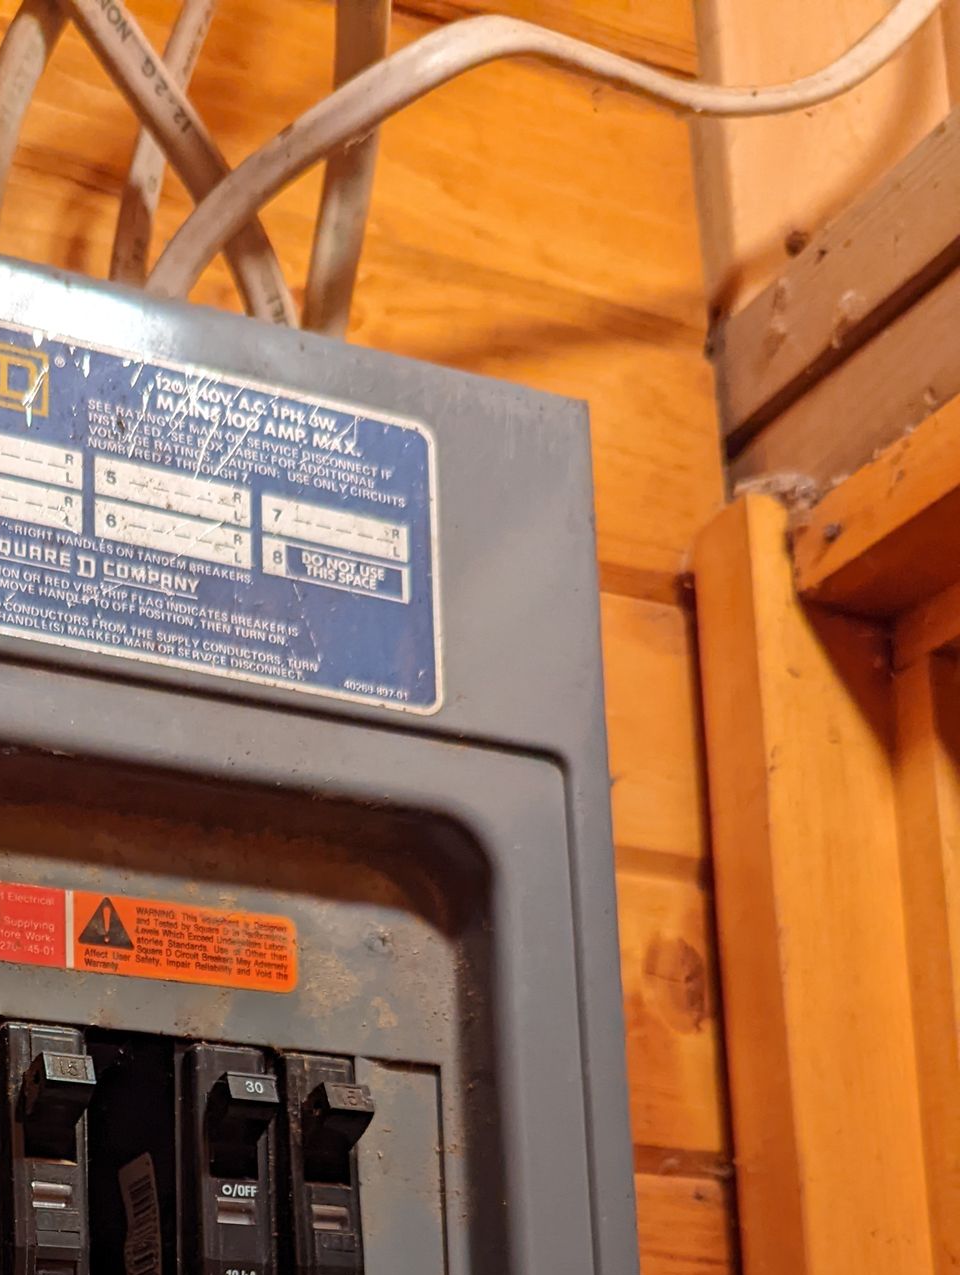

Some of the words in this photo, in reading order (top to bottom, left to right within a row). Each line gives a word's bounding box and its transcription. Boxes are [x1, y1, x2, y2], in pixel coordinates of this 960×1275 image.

[88, 399, 111, 413] SEE
[116, 406, 165, 426] RATING
[169, 418, 185, 431] OF
[189, 422, 221, 439] MAIN
[247, 437, 298, 458] SERVICE
[302, 450, 377, 477] DISCONNECT
[381, 469, 391, 481] IF
[227, 411, 259, 433] 100
[263, 420, 307, 444] AMP.
[312, 432, 361, 457] MAX.
[65, 453, 73, 465] R
[88, 412, 164, 439] INSTLLED.
[171, 431, 193, 446] SEE
[197, 437, 222, 452] BOX
[271, 455, 295, 470] FOR
[300, 462, 374, 489] ADDITIONAL
[88, 437, 161, 463] NUMBERED
[164, 454, 171, 465] 2
[176, 457, 236, 480] THROUGH
[106, 470, 116, 485] 5
[287, 471, 309, 486] USE
[313, 477, 346, 494] ONLY
[350, 485, 405, 508] CIRCUITS
[64, 496, 72, 507] R
[233, 492, 241, 503] R
[105, 513, 116, 528] 6
[272, 508, 281, 523] 7
[233, 533, 241, 545] R
[392, 528, 399, 539] R
[56, 533, 112, 554] HANDLES
[116, 546, 133, 559] ON
[138, 551, 185, 569] TANDEM
[272, 550, 282, 564] 8
[302, 551, 322, 567] DO
[326, 557, 356, 574] NOT
[360, 565, 384, 581] USE
[77, 555, 95, 579] D
[103, 560, 199, 593] COMPANY
[305, 565, 335, 581] THIS
[338, 572, 376, 590] SPACE
[0, 577, 34, 594] MOVE
[112, 601, 135, 615] OFF
[139, 606, 197, 629] POSITION,
[201, 619, 229, 635] THEN
[234, 626, 266, 642] TURN
[23, 572, 41, 584] OR
[44, 576, 68, 590] RED
[132, 593, 162, 609] FLAG
[166, 601, 227, 622] INDICATES
[230, 615, 286, 635] BREAKER
[288, 627, 298, 638] IS
[4, 600, 87, 627] CONDUCTORS
[92, 619, 126, 634] FROM
[130, 626, 152, 639] THE
[156, 631, 198, 648] SUPPLY
[287, 658, 318, 674] TURN
[67, 625, 120, 644] MARKED
[123, 636, 153, 651] MAIN
[157, 643, 174, 655] OR
[245, 1080, 264, 1095] 30
